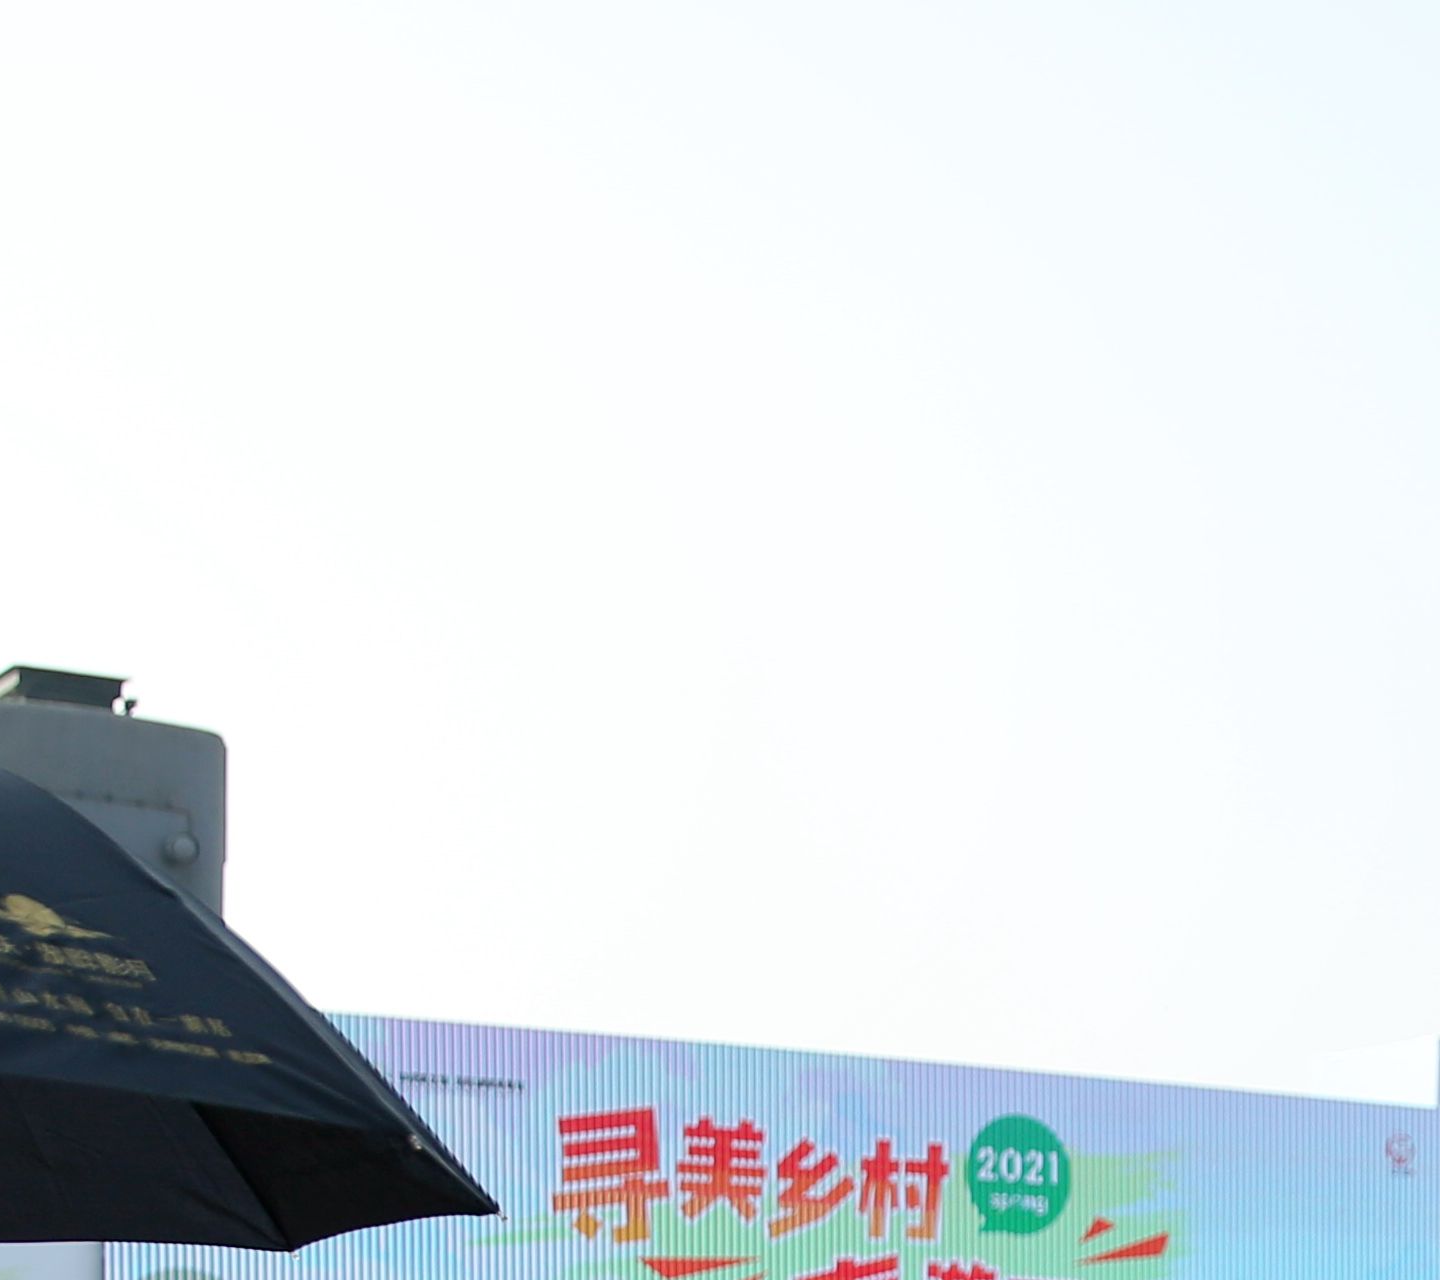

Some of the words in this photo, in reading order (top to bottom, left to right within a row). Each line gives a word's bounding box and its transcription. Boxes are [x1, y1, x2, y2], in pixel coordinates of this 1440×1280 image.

[552, 1106, 950, 1246] 寻美乡村
[977, 1145, 1059, 1187] 2021
